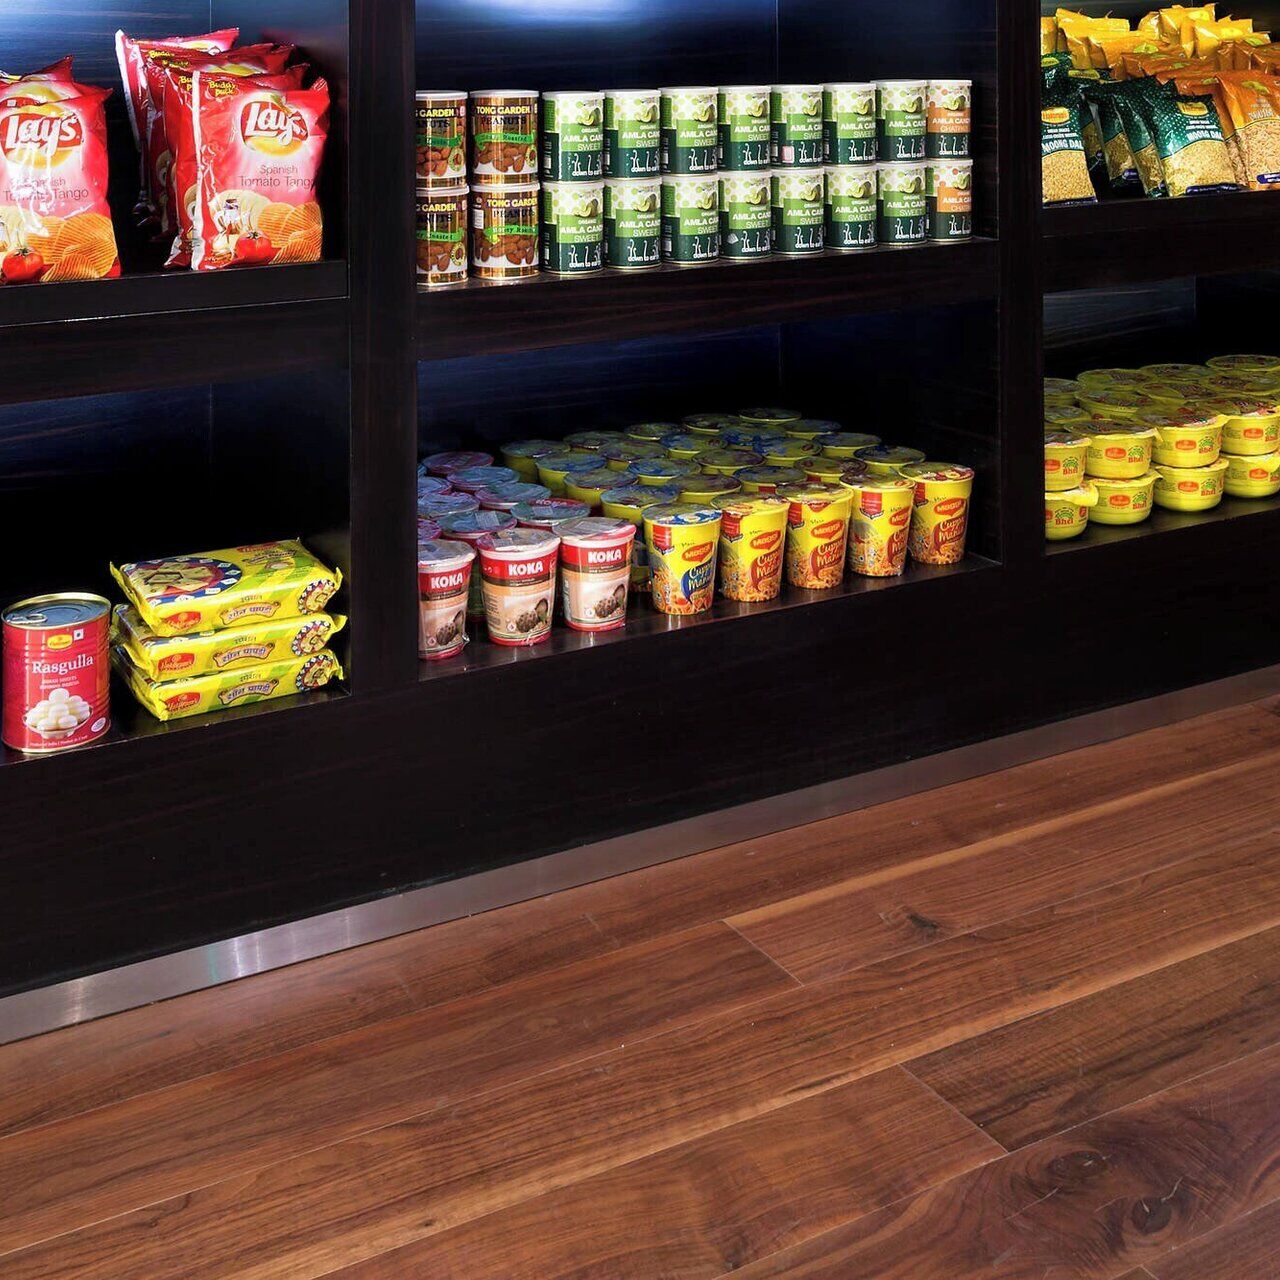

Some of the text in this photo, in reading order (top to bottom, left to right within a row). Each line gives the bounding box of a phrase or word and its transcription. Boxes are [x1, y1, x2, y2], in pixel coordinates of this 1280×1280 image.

[476, 105, 531, 114] TONG GARDEN
[480, 116, 527, 125] PEANUTS
[734, 125, 758, 133] AMLA
[791, 124, 813, 132] AMLA
[840, 122, 863, 131] AMLA
[564, 134, 589, 142] AMLA
[622, 131, 646, 139] AMLA
[680, 130, 704, 138] AMLA
[747, 133, 768, 142] SWEET
[1187, 131, 1210, 141] MOONG
[577, 142, 602, 151] SWEET
[636, 139, 659, 148] SWEET
[1042, 139, 1068, 151] MOONG
[259, 165, 298, 176] Spanish
[239, 175, 280, 187] Tomato
[53, 188, 89, 202] Tango
[422, 202, 457, 212] GARDEN
[486, 199, 511, 207] TONG
[886, 200, 910, 208] AMLA
[732, 212, 756, 220] AMLA
[787, 208, 811, 217] AMLA
[899, 208, 922, 217] SWEET
[683, 218, 707, 226] AMLA
[847, 214, 872, 222] SWEET
[619, 220, 644, 228] AMLA
[745, 221, 768, 230] SWEET
[560, 225, 585, 234] AMLA
[632, 228, 658, 237] SWEET
[574, 234, 600, 242] SWEET
[588, 549, 623, 563] KOKA
[508, 560, 544, 576] KOKA
[431, 572, 464, 589] KOKA
[30, 653, 95, 676] Rasgulla
